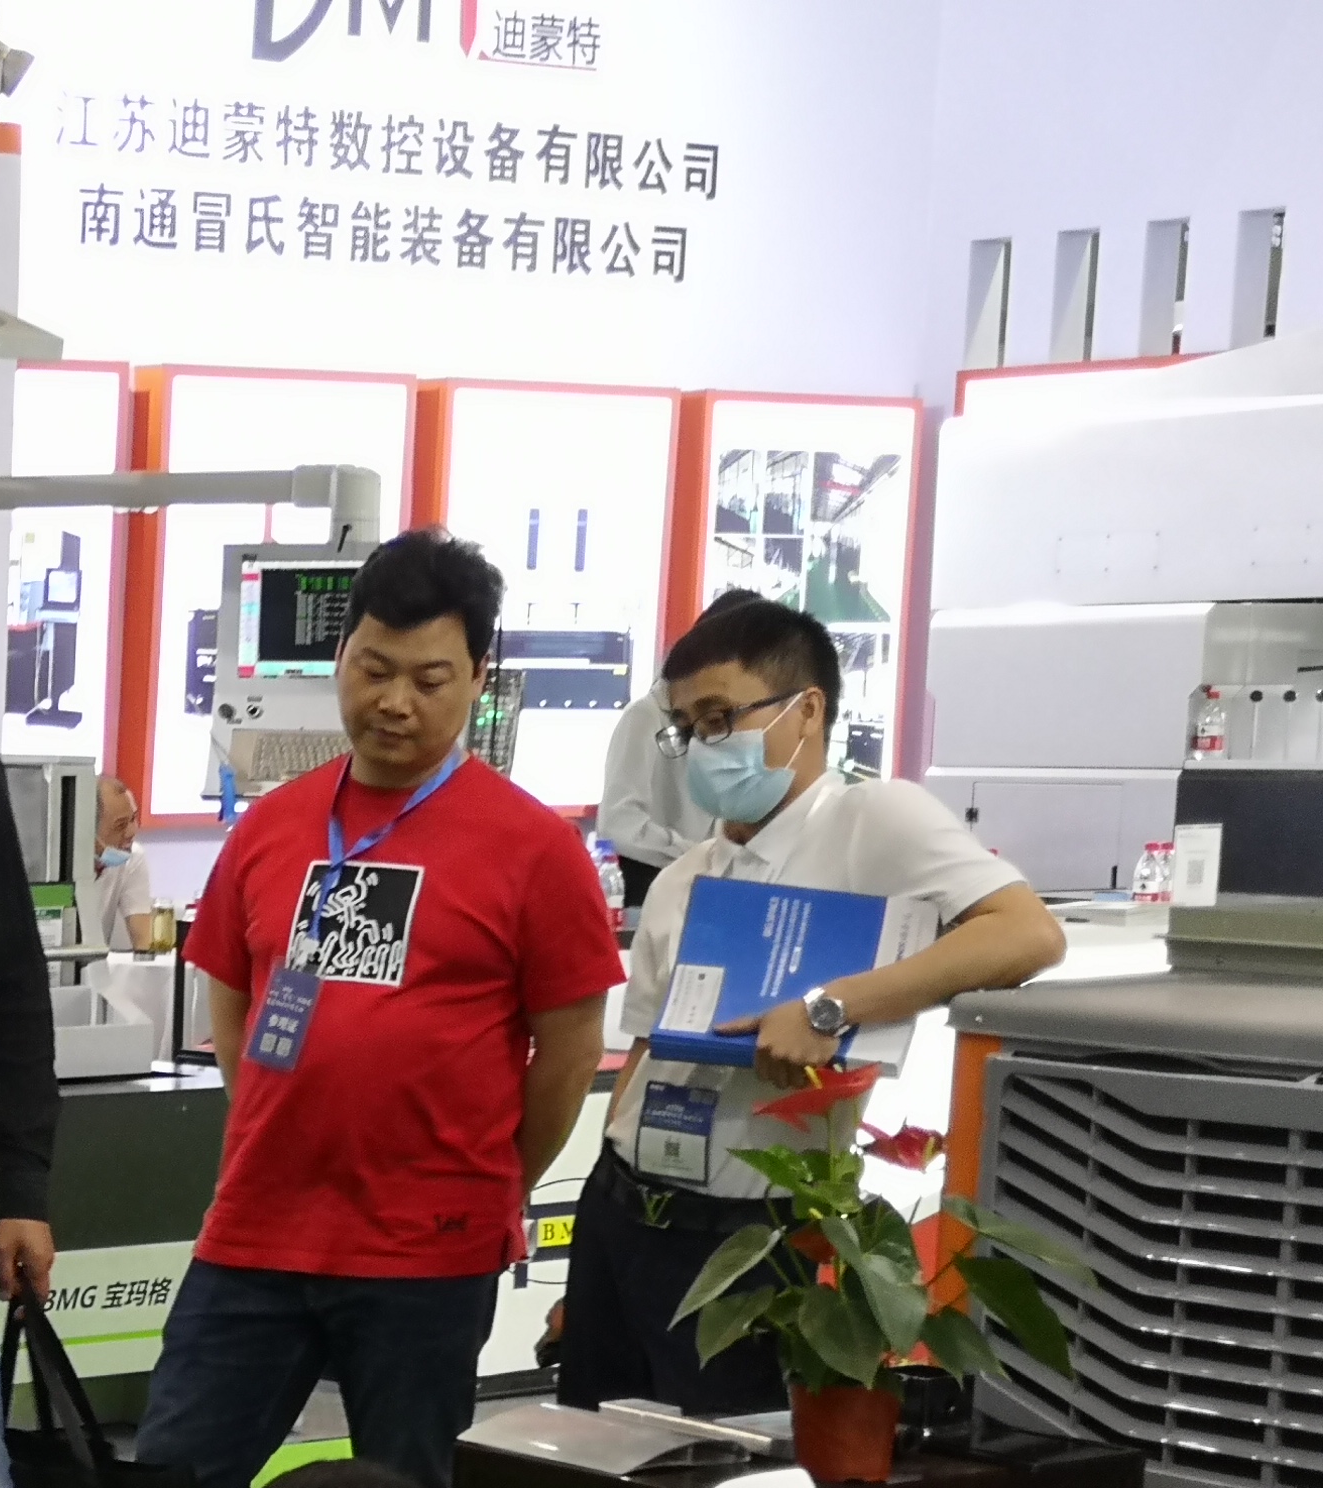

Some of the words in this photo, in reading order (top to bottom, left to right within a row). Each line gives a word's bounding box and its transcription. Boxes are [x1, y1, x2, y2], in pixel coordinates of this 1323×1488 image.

[492, 10, 601, 66] 迪蒙特
[55, 90, 721, 201] 江苏迪蒙特数控设备有限公司
[78, 182, 690, 284] 南通冒氏智能装备有限公司
[101, 1277, 173, 1310] 宝玛格
